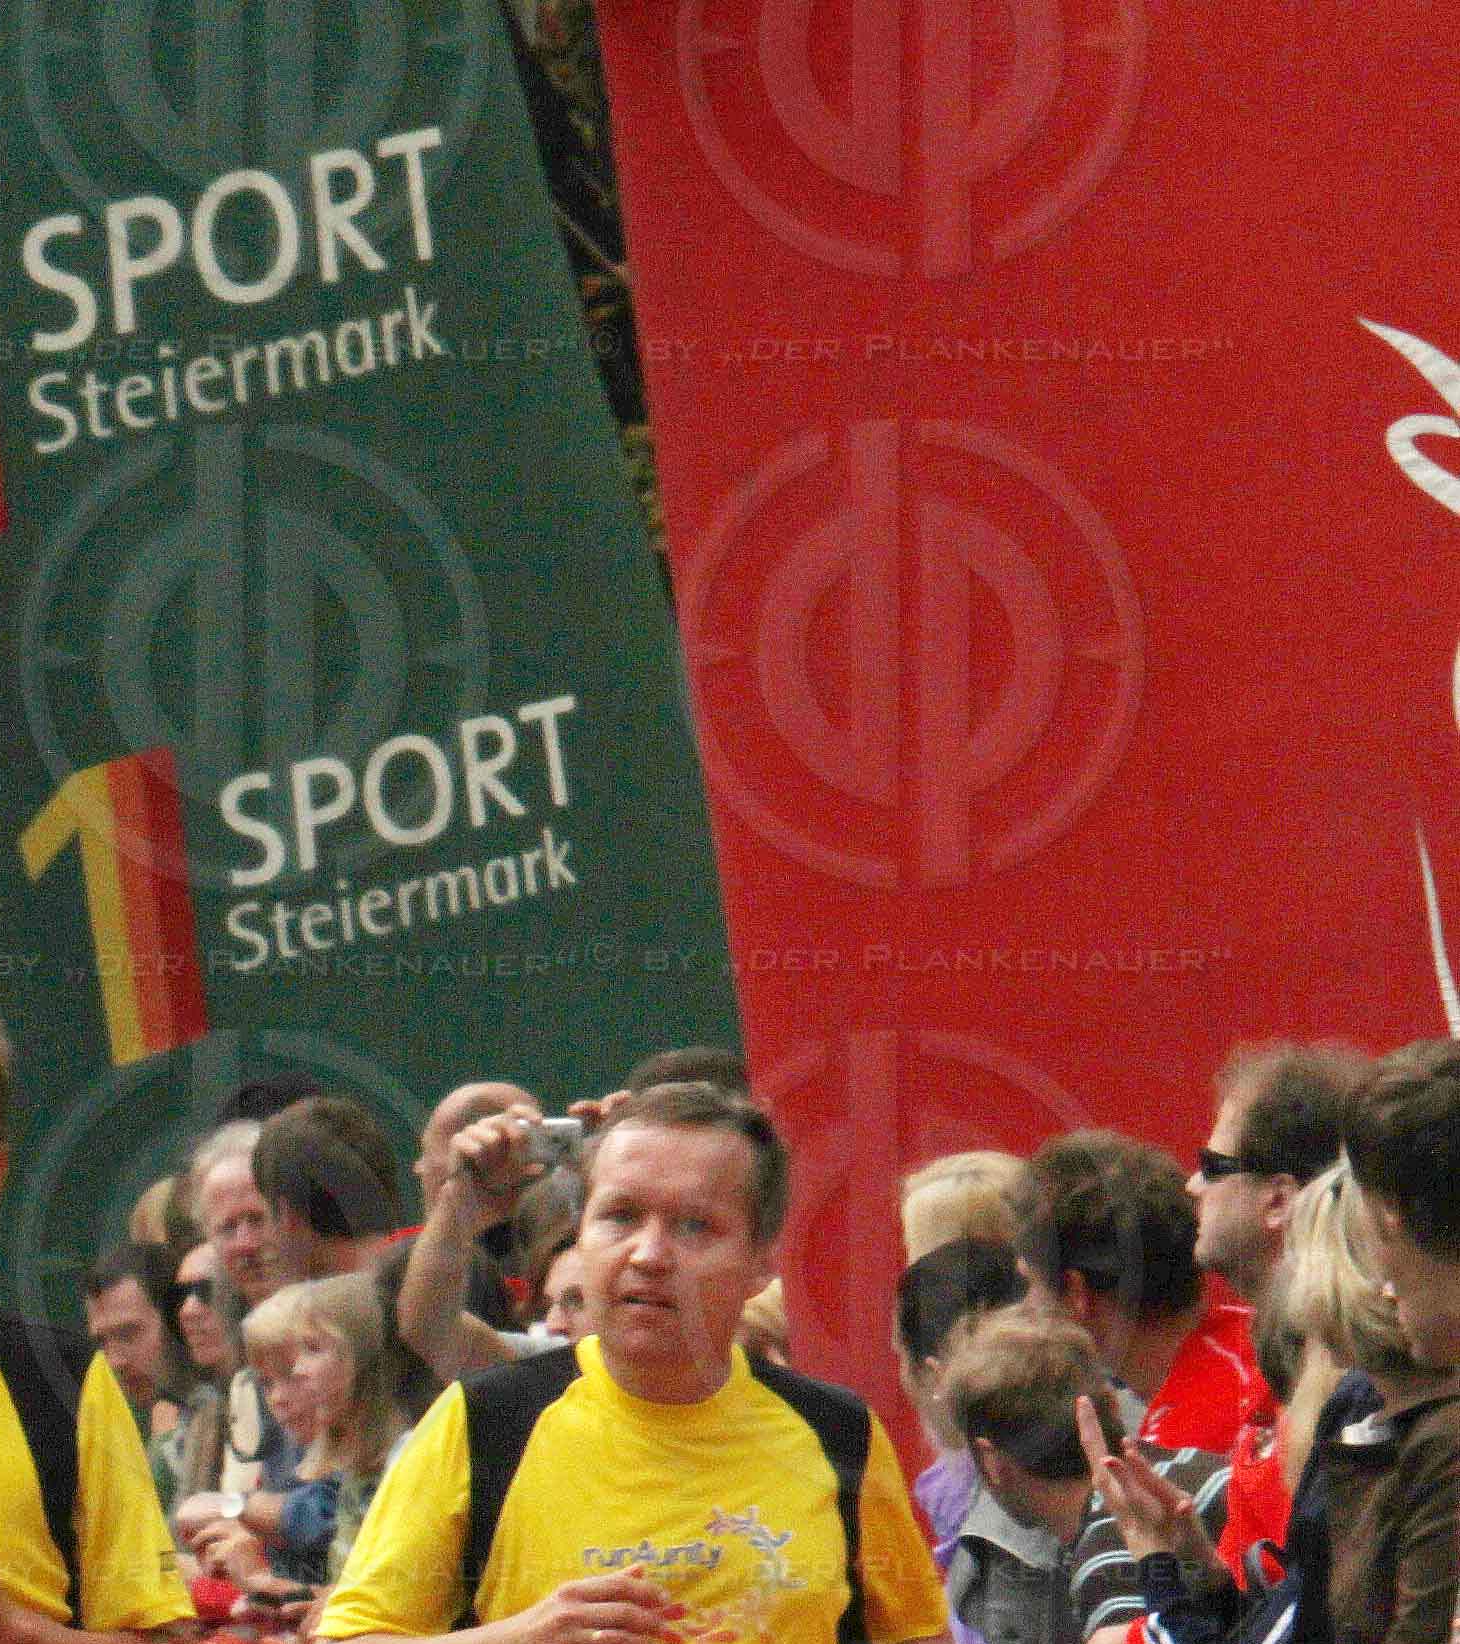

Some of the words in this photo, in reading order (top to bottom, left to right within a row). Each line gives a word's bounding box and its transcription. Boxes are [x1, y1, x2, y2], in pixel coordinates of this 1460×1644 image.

[22, 127, 442, 352] SPORT
[30, 289, 442, 454] Steiermark
[219, 696, 576, 886] SPORT
[21, 746, 208, 1066] 1
[227, 828, 576, 972] Steiermark
